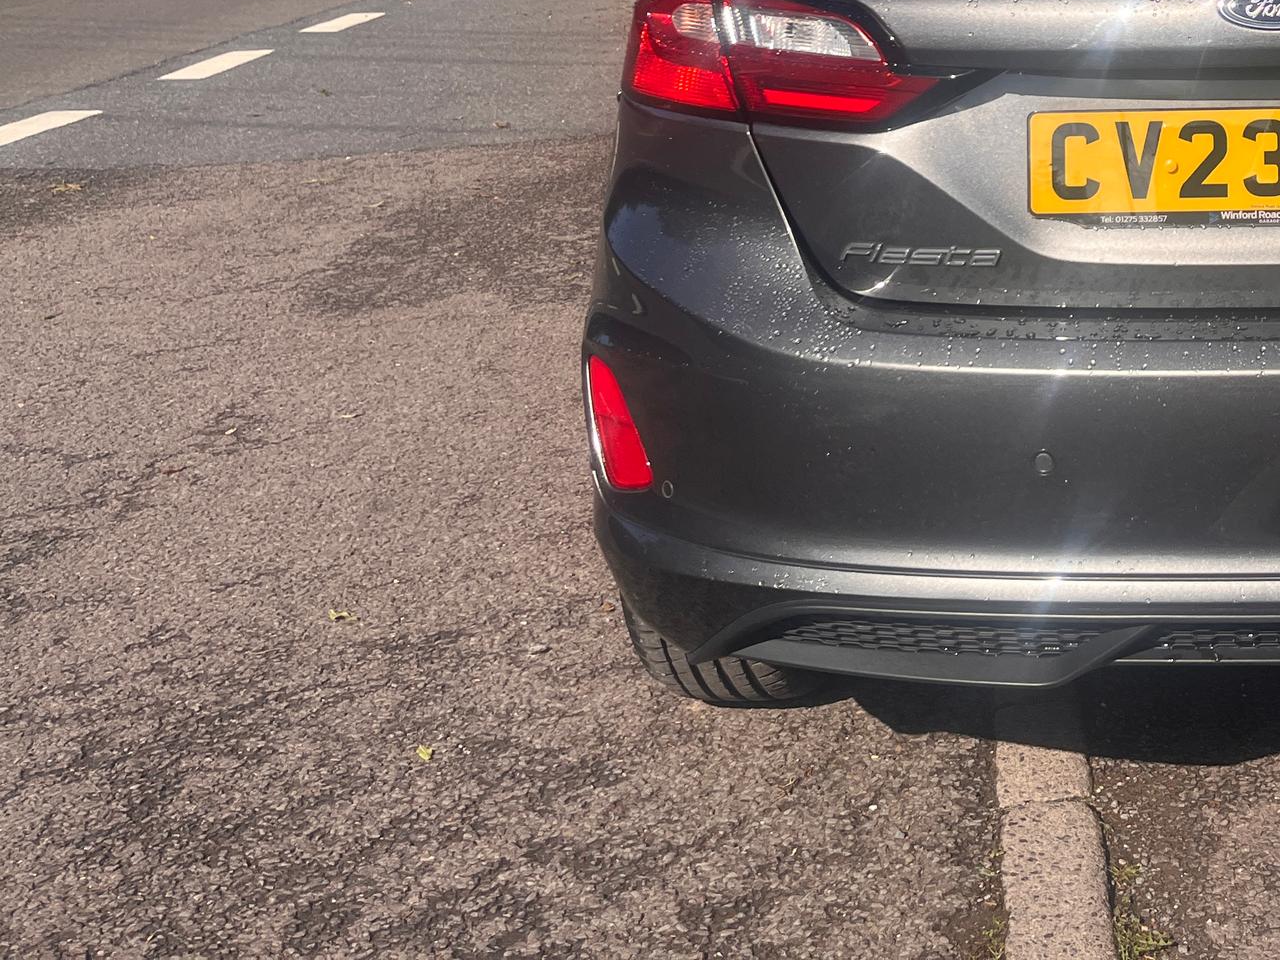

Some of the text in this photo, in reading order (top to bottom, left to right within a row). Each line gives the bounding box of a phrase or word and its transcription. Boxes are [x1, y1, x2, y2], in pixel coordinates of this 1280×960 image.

[1100, 215, 1114, 223] Tel:
[1115, 215, 1138, 223] 01275
[1220, 210, 1258, 220] Winford
[839, 242, 1002, 267] Fiesta
